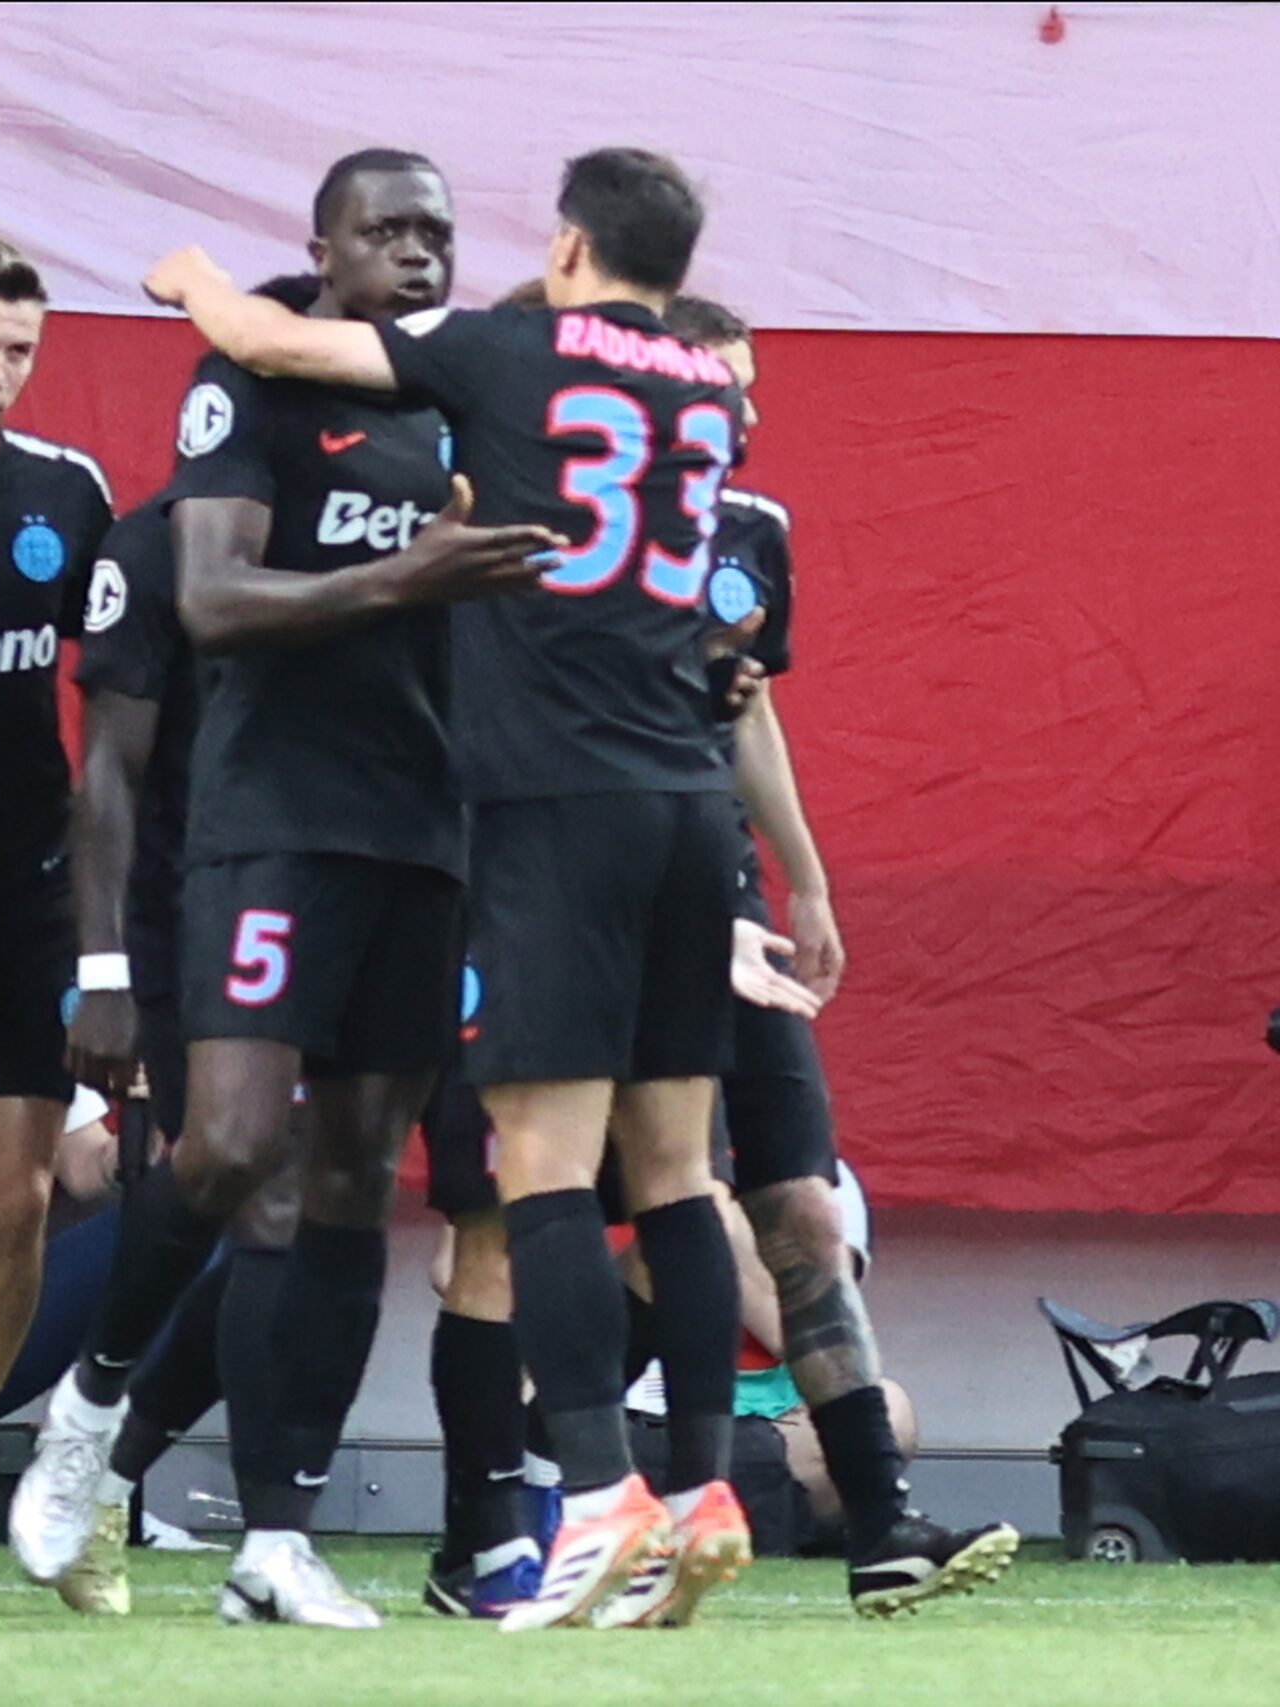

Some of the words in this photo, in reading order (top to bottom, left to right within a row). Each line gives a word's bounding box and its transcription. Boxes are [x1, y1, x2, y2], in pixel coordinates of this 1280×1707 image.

[317, 490, 437, 550] Bet
[525, 386, 732, 607] 33
[225, 907, 293, 1007] 5
